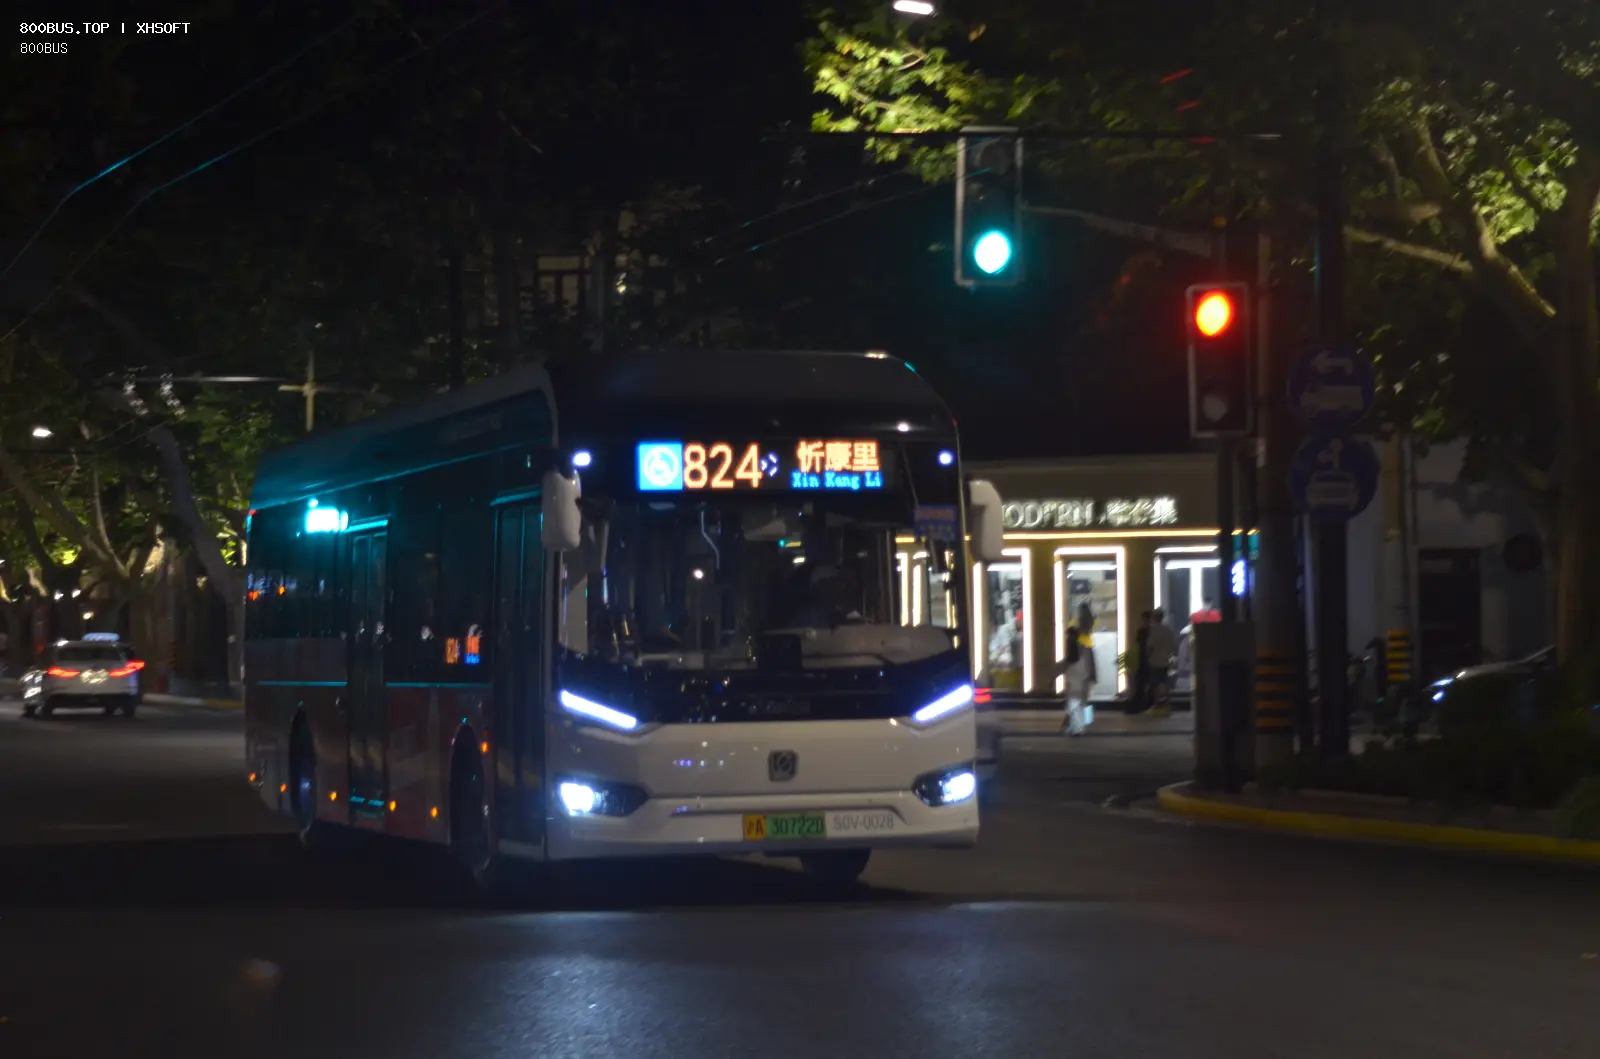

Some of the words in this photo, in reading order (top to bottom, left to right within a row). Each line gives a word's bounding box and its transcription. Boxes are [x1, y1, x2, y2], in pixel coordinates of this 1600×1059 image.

[683, 443, 762, 489] 824
[792, 471, 819, 488] Xin
[824, 471, 859, 490] Kang
[864, 471, 882, 487] Li
[1002, 500, 1093, 527] ODERN
